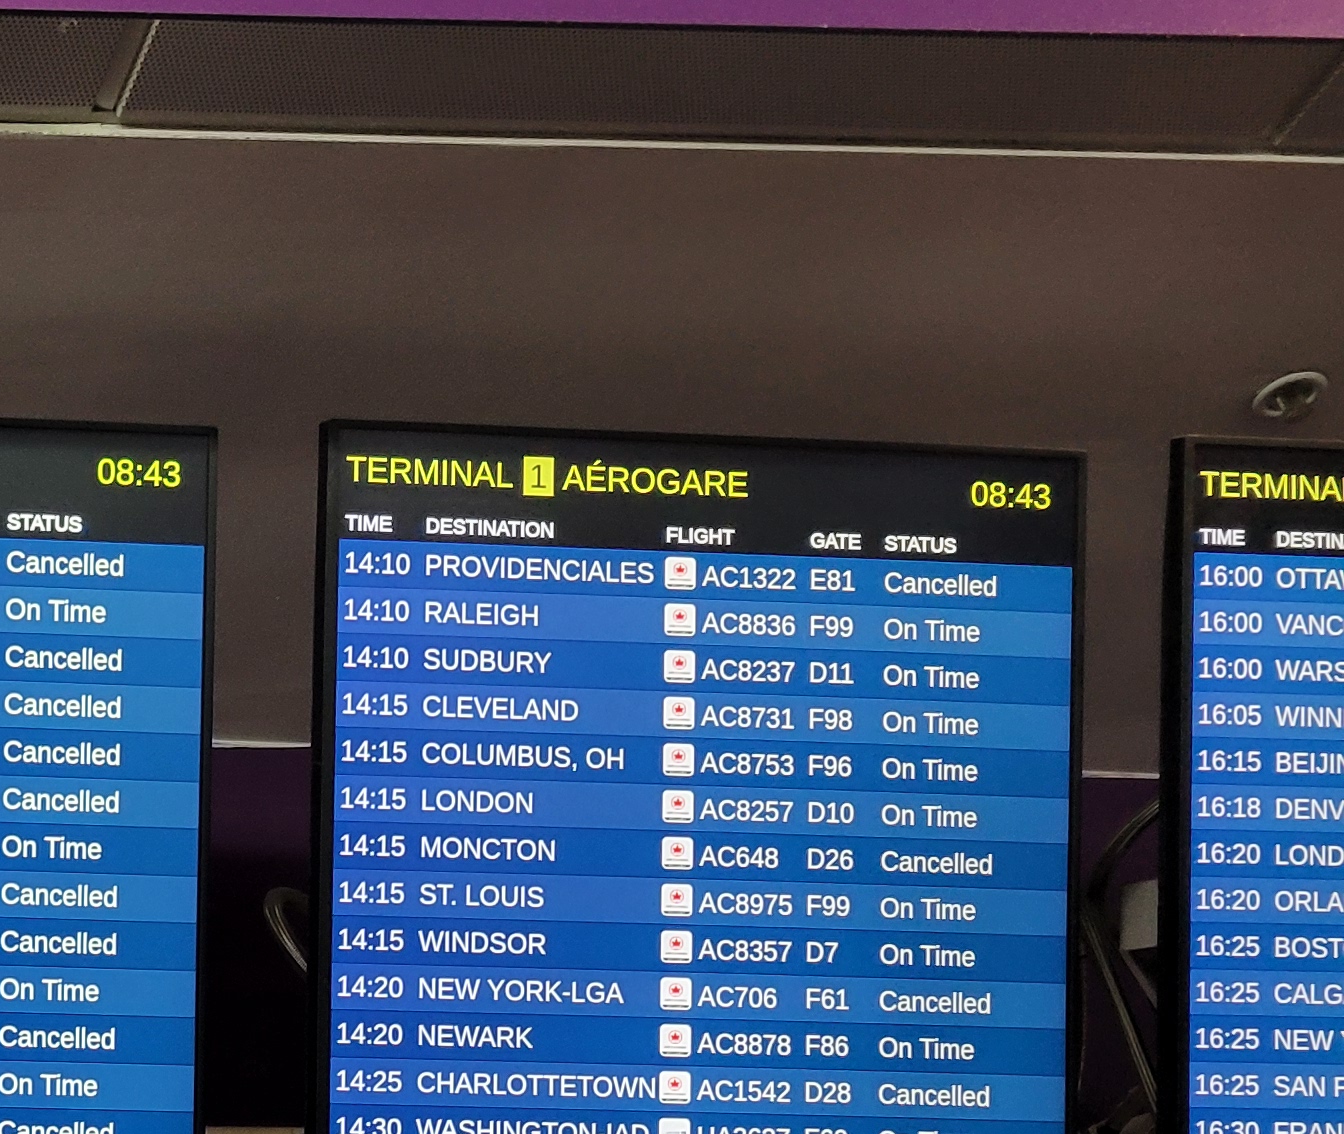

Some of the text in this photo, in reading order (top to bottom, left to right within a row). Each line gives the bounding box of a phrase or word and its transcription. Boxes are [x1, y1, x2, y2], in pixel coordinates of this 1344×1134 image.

[98, 458, 180, 487] 08:43
[346, 456, 513, 488] TERMINAL
[562, 460, 748, 497] AÉROGARE
[1200, 471, 1344, 502] TERMINA
[971, 481, 1051, 509] 08:43
[7, 513, 82, 533] STATUS
[345, 514, 957, 553] TIME DESTINATION FLIGHT GATE STATUS
[1199, 528, 1245, 545] TIME
[346, 552, 996, 596] 14:10 PROVIDENCIALES AC1322 E81 Cancelled
[6, 598, 40, 620] On
[48, 599, 106, 623] Time
[2, 836, 36, 857] On
[44, 837, 102, 859] Time
[340, 834, 992, 875] 14:15 MONCTON AC648 D26 Cancelled
[1195, 1074, 1325, 1097] 16:25 SAN
